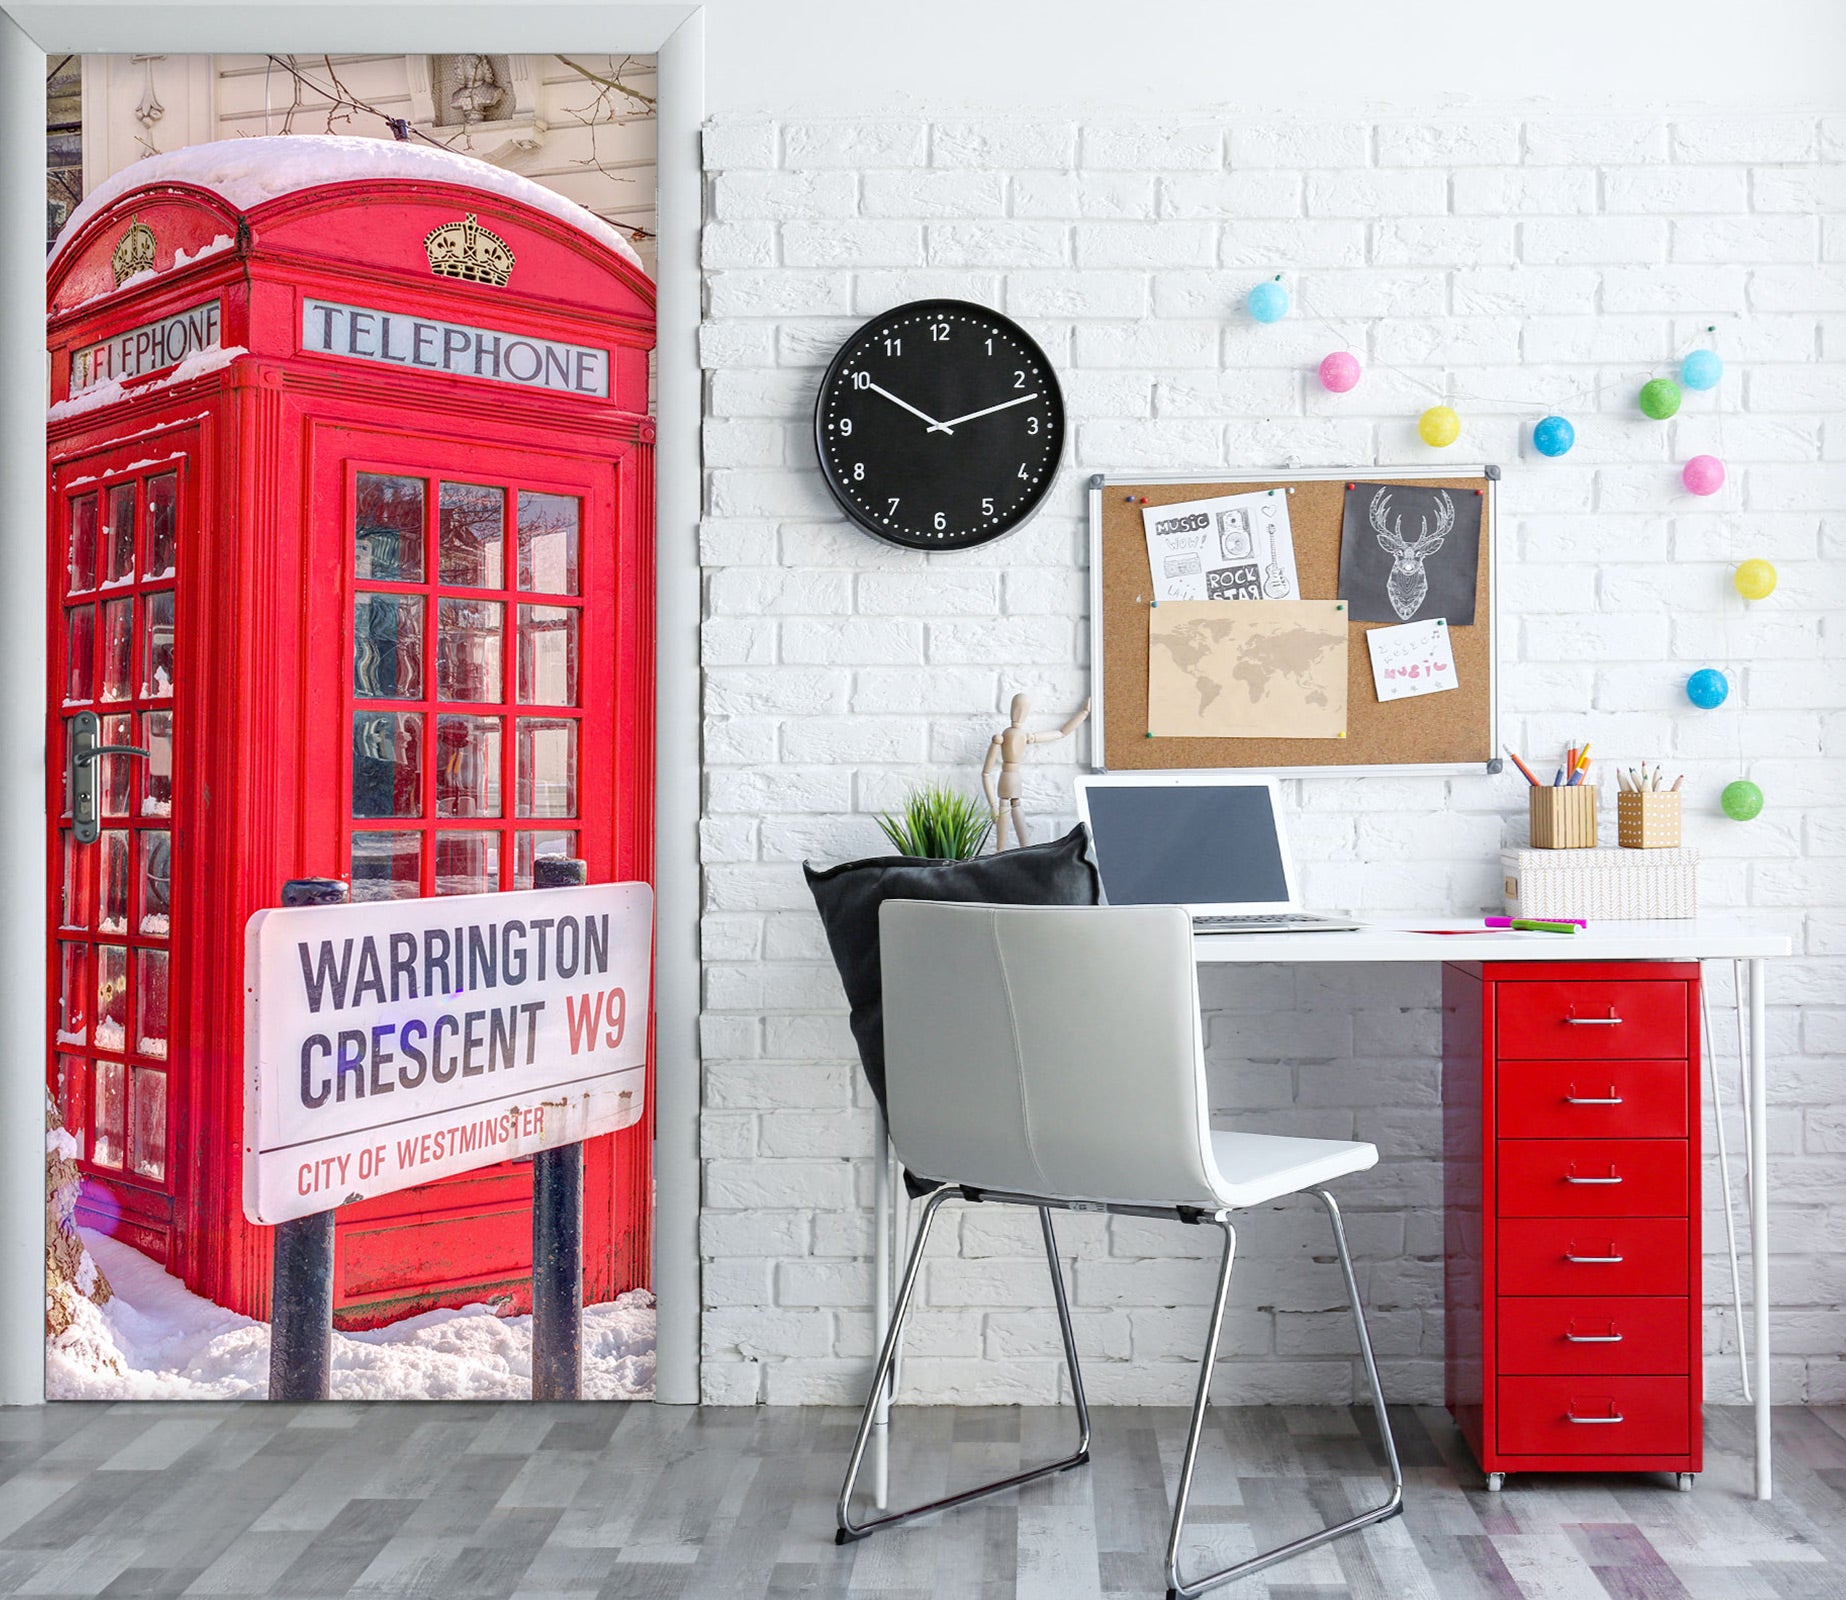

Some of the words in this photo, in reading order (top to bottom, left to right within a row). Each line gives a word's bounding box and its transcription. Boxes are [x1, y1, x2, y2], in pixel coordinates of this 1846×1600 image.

[930, 324, 950, 341] 12
[312, 305, 599, 393] TELEPHONE
[884, 339, 902, 356] 11
[985, 339, 993, 355] 1
[851, 371, 870, 389] 10
[1014, 371, 1025, 388] 2
[840, 419, 852, 436] 9
[1027, 418, 1038, 434] 3
[854, 463, 865, 481] 8
[1018, 463, 1028, 480] 4
[888, 498, 900, 515] 7
[982, 498, 994, 515] 5
[934, 513, 946, 529] 6
[1210, 568, 1257, 588] ROCK
[298, 914, 609, 1013] WARRINGTON
[300, 1001, 545, 1109] CRESCENT
[566, 987, 626, 1055] W9
[297, 1154, 351, 1196] CITY
[359, 1145, 386, 1180] OF
[396, 1107, 545, 1169] WESTMINSTER
